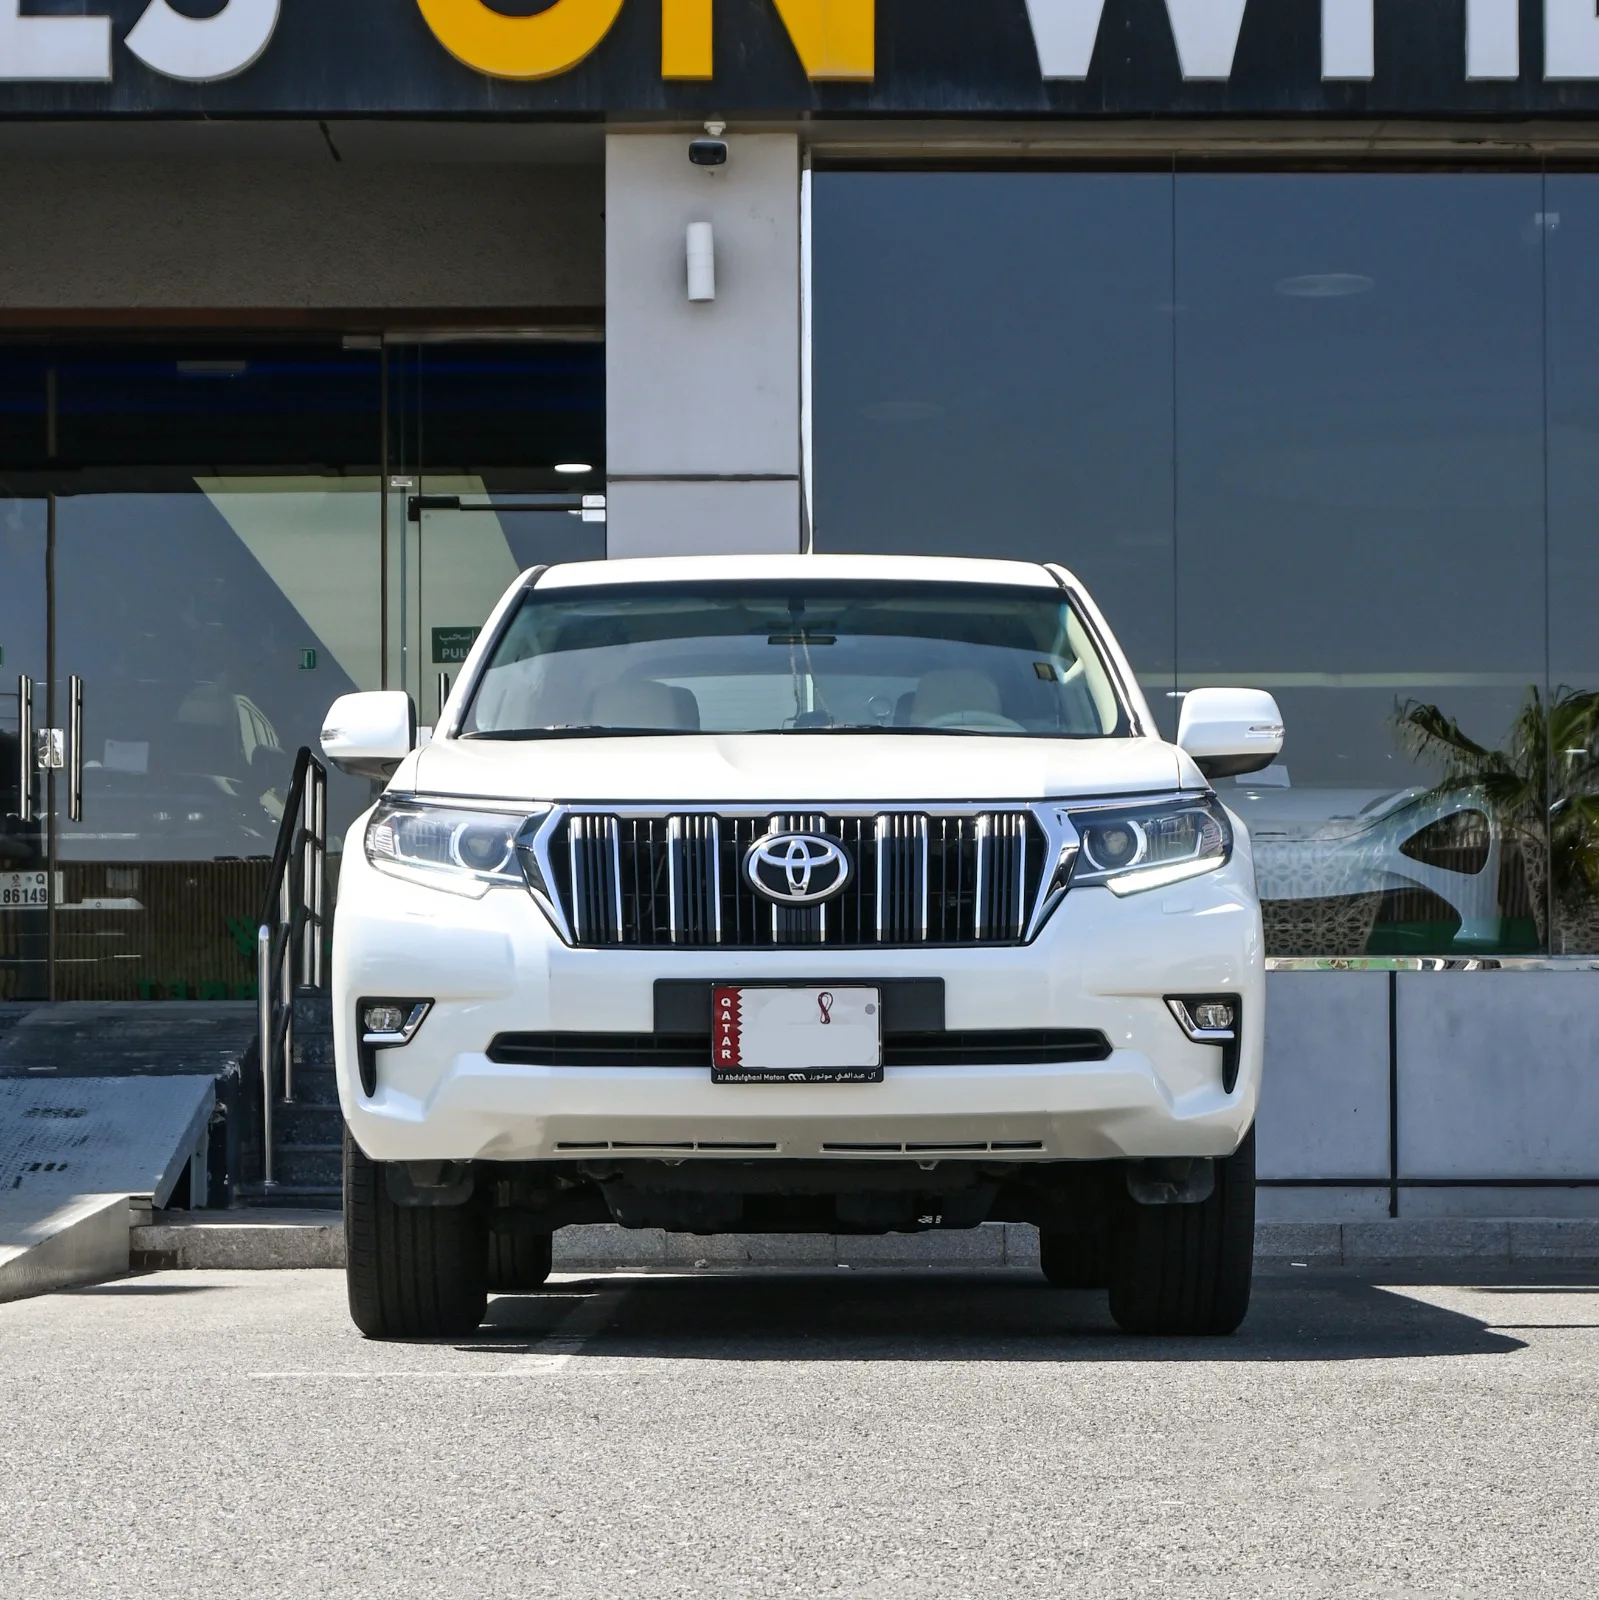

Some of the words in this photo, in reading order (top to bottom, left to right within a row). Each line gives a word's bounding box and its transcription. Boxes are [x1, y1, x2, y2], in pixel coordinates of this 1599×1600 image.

[36, 873, 45, 884] Q
[3, 888, 47, 903] 86149
[721, 998, 732, 1059] QATAR
[717, 1073, 724, 1081] Al
[763, 1073, 786, 1081] Motors
